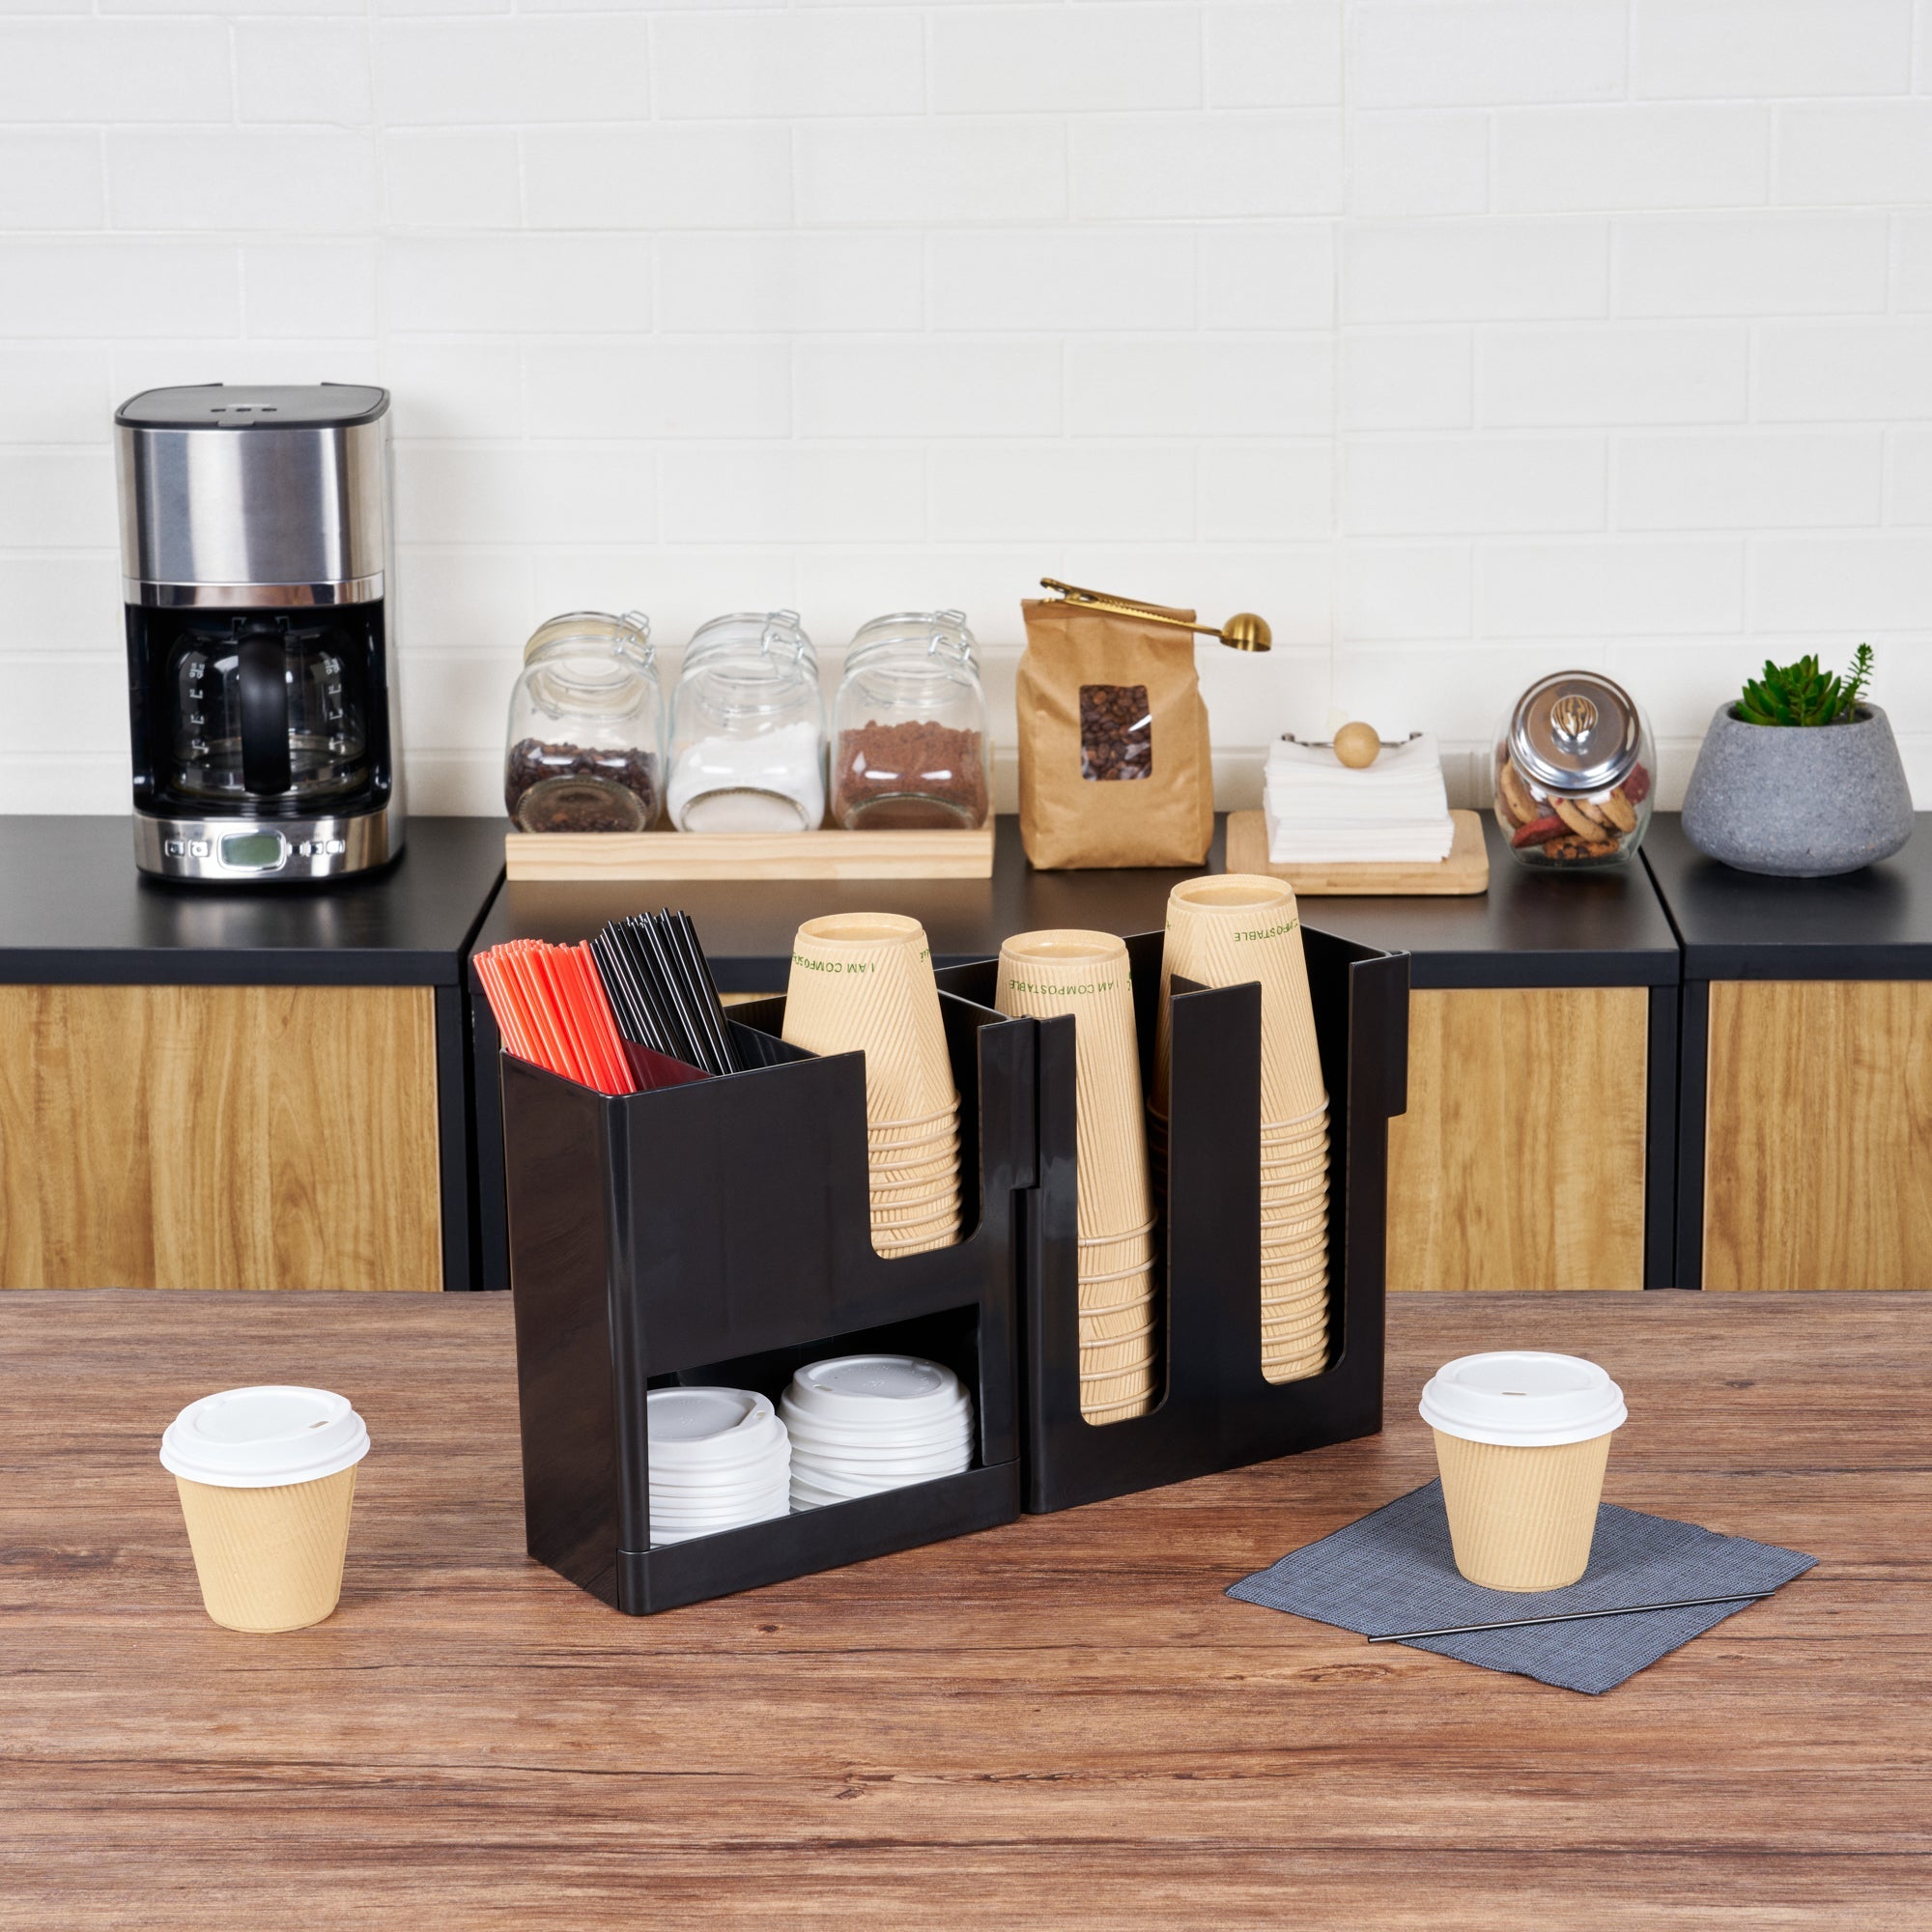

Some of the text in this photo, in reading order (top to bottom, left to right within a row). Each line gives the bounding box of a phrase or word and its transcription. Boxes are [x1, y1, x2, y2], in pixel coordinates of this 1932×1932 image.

[847, 962, 867, 973] AM
[870, 962, 875, 973] I
[1009, 980, 1094, 995] COMPOSTABLE
[1098, 980, 1114, 992] AM
